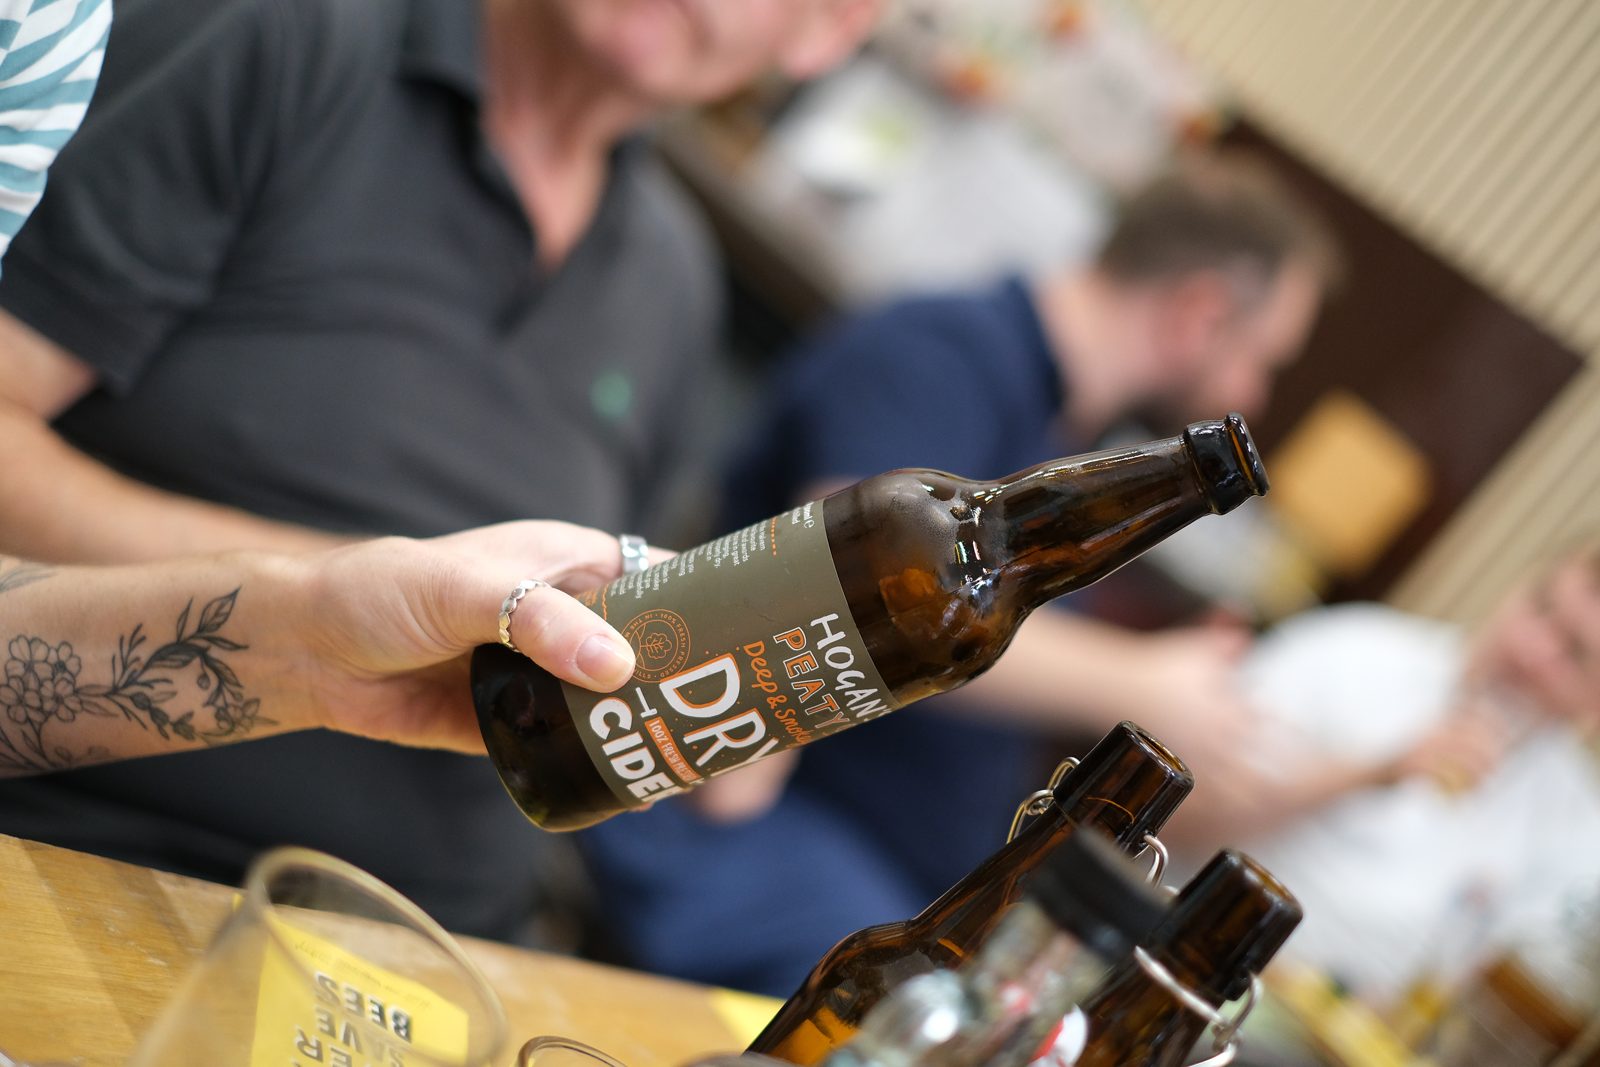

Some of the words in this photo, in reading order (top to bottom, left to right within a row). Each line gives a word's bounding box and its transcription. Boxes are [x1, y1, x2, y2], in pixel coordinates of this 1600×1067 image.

[676, 623, 687, 648] FRESH
[743, 640, 778, 694] Deep
[767, 696, 788, 710] &
[772, 626, 850, 729] PEATY
[649, 720, 670, 743] 100%
[661, 742, 681, 765] FRESH
[658, 650, 779, 776] DRY
[314, 971, 413, 1043] BEES
